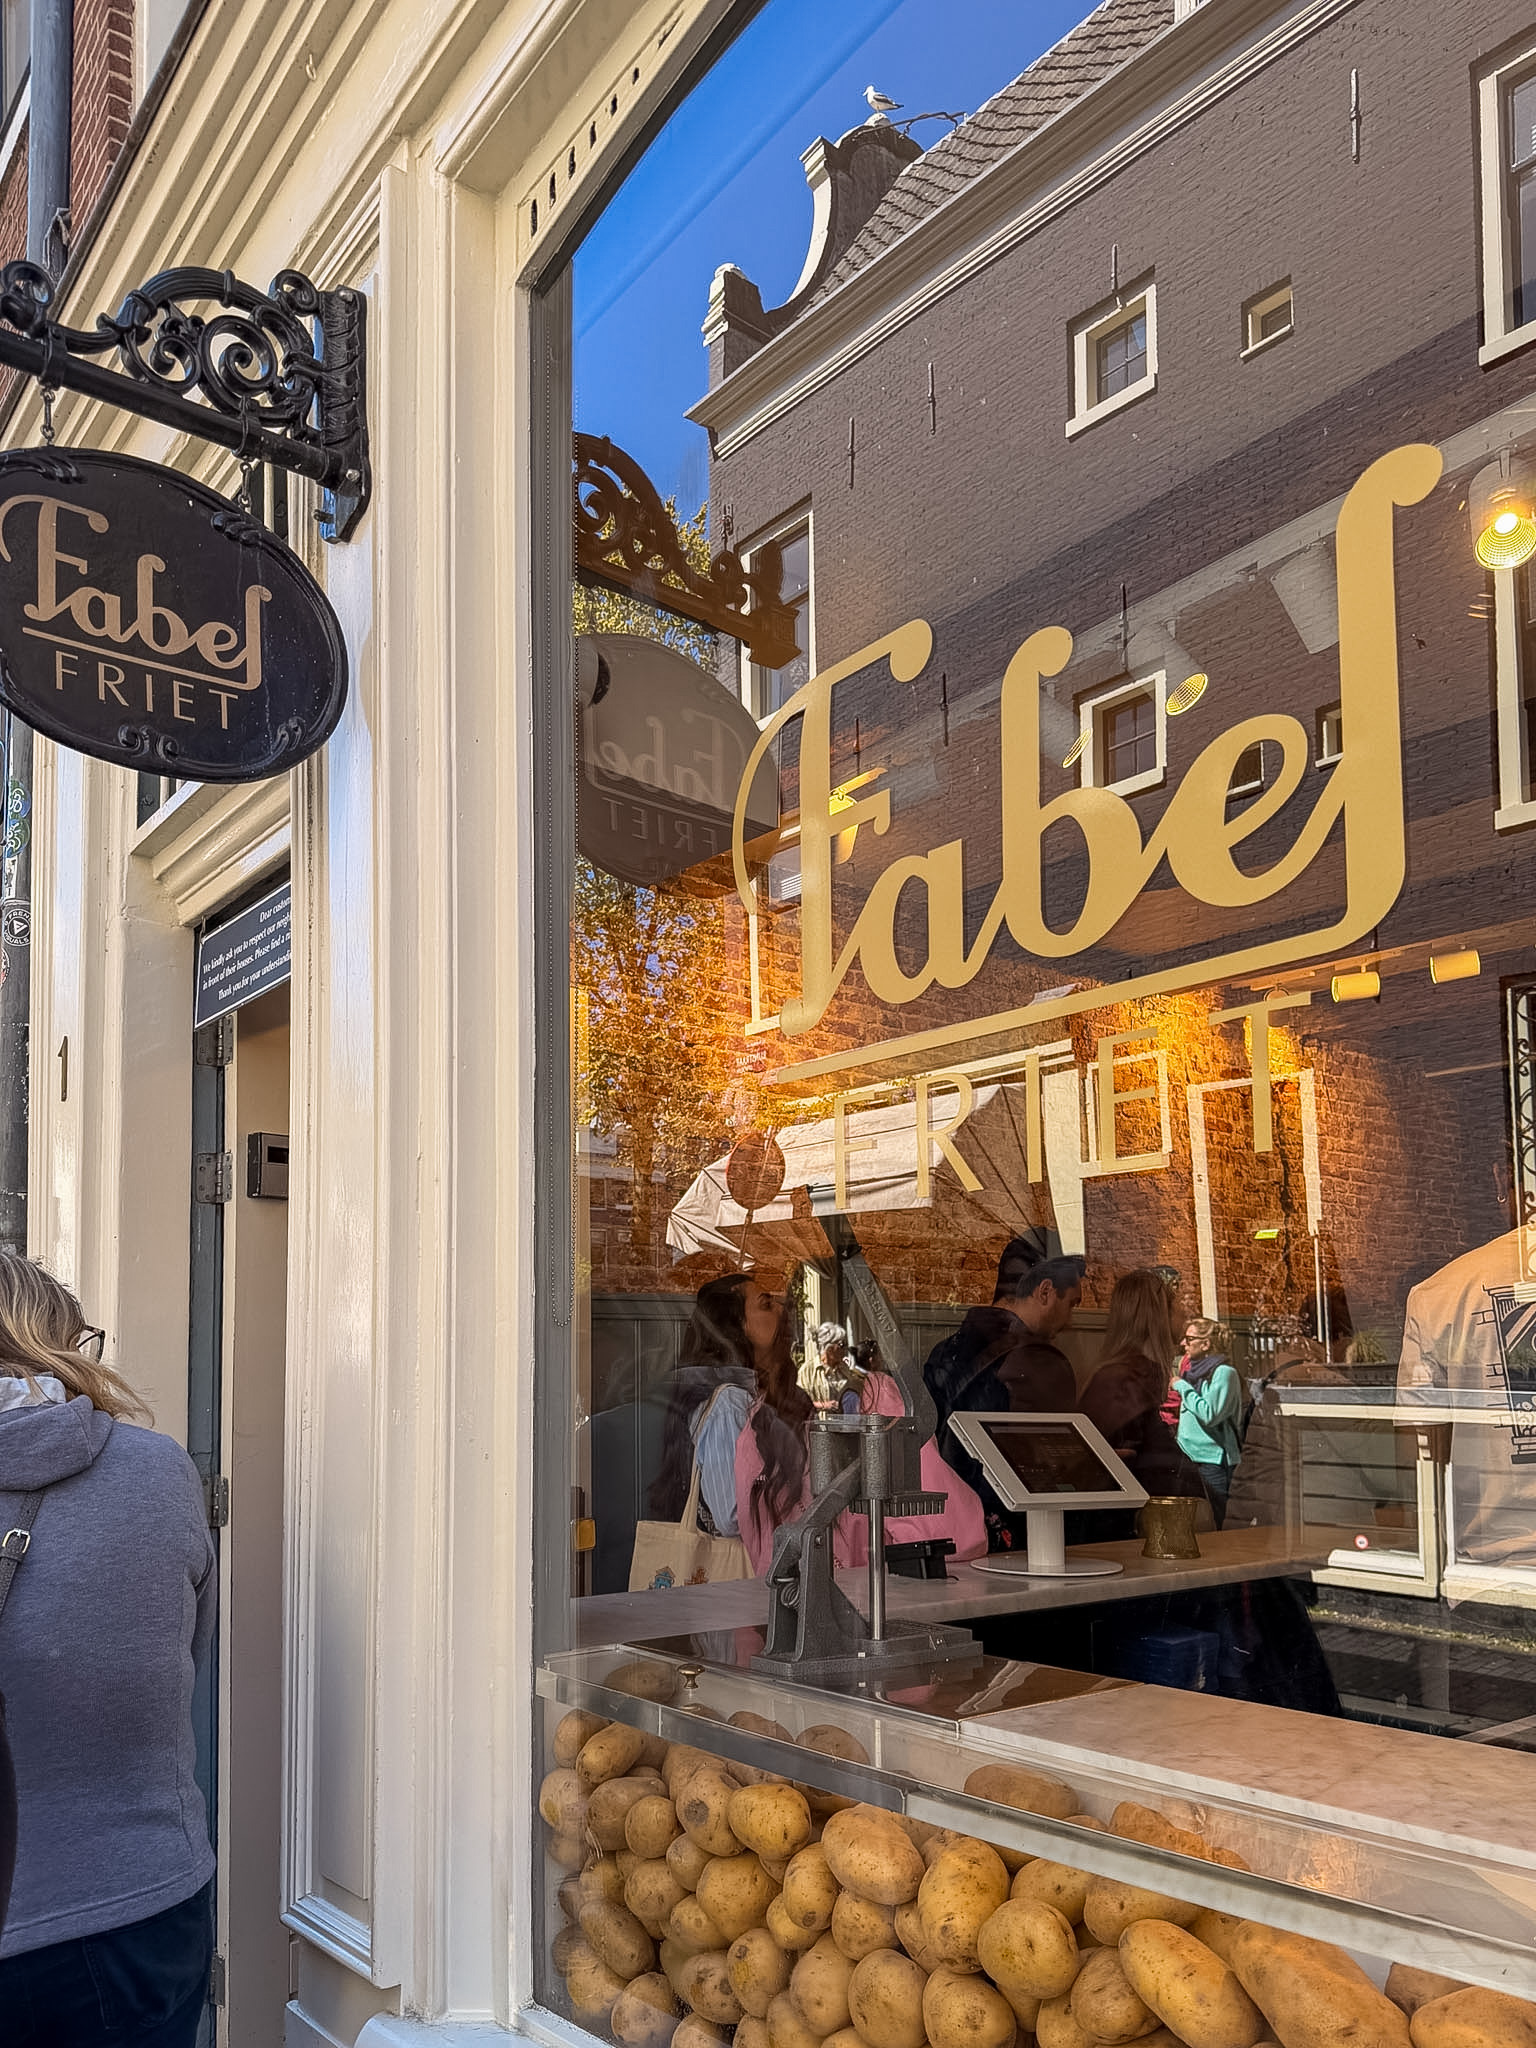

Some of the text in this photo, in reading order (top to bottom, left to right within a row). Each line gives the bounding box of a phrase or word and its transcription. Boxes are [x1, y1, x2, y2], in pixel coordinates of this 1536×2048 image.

[0, 494, 272, 690] Fabel
[55, 651, 238, 730] FRIET
[733, 443, 1443, 1036] Fabel
[203, 963, 211, 974] We
[211, 953, 225, 969] kindly
[225, 948, 233, 961] ask
[233, 944, 243, 959] you
[249, 928, 266, 947] respect
[267, 923, 276, 935] our
[260, 909, 272, 923] Dear
[208, 973, 219, 987] front
[225, 962, 236, 977] their
[254, 944, 270, 960] Please
[271, 934, 280, 950] find
[219, 983, 232, 1000] Thank
[232, 980, 242, 996] you
[250, 969, 261, 986] your
[57, 1035, 68, 1102] 1
[834, 991, 1311, 1211] FRIET
